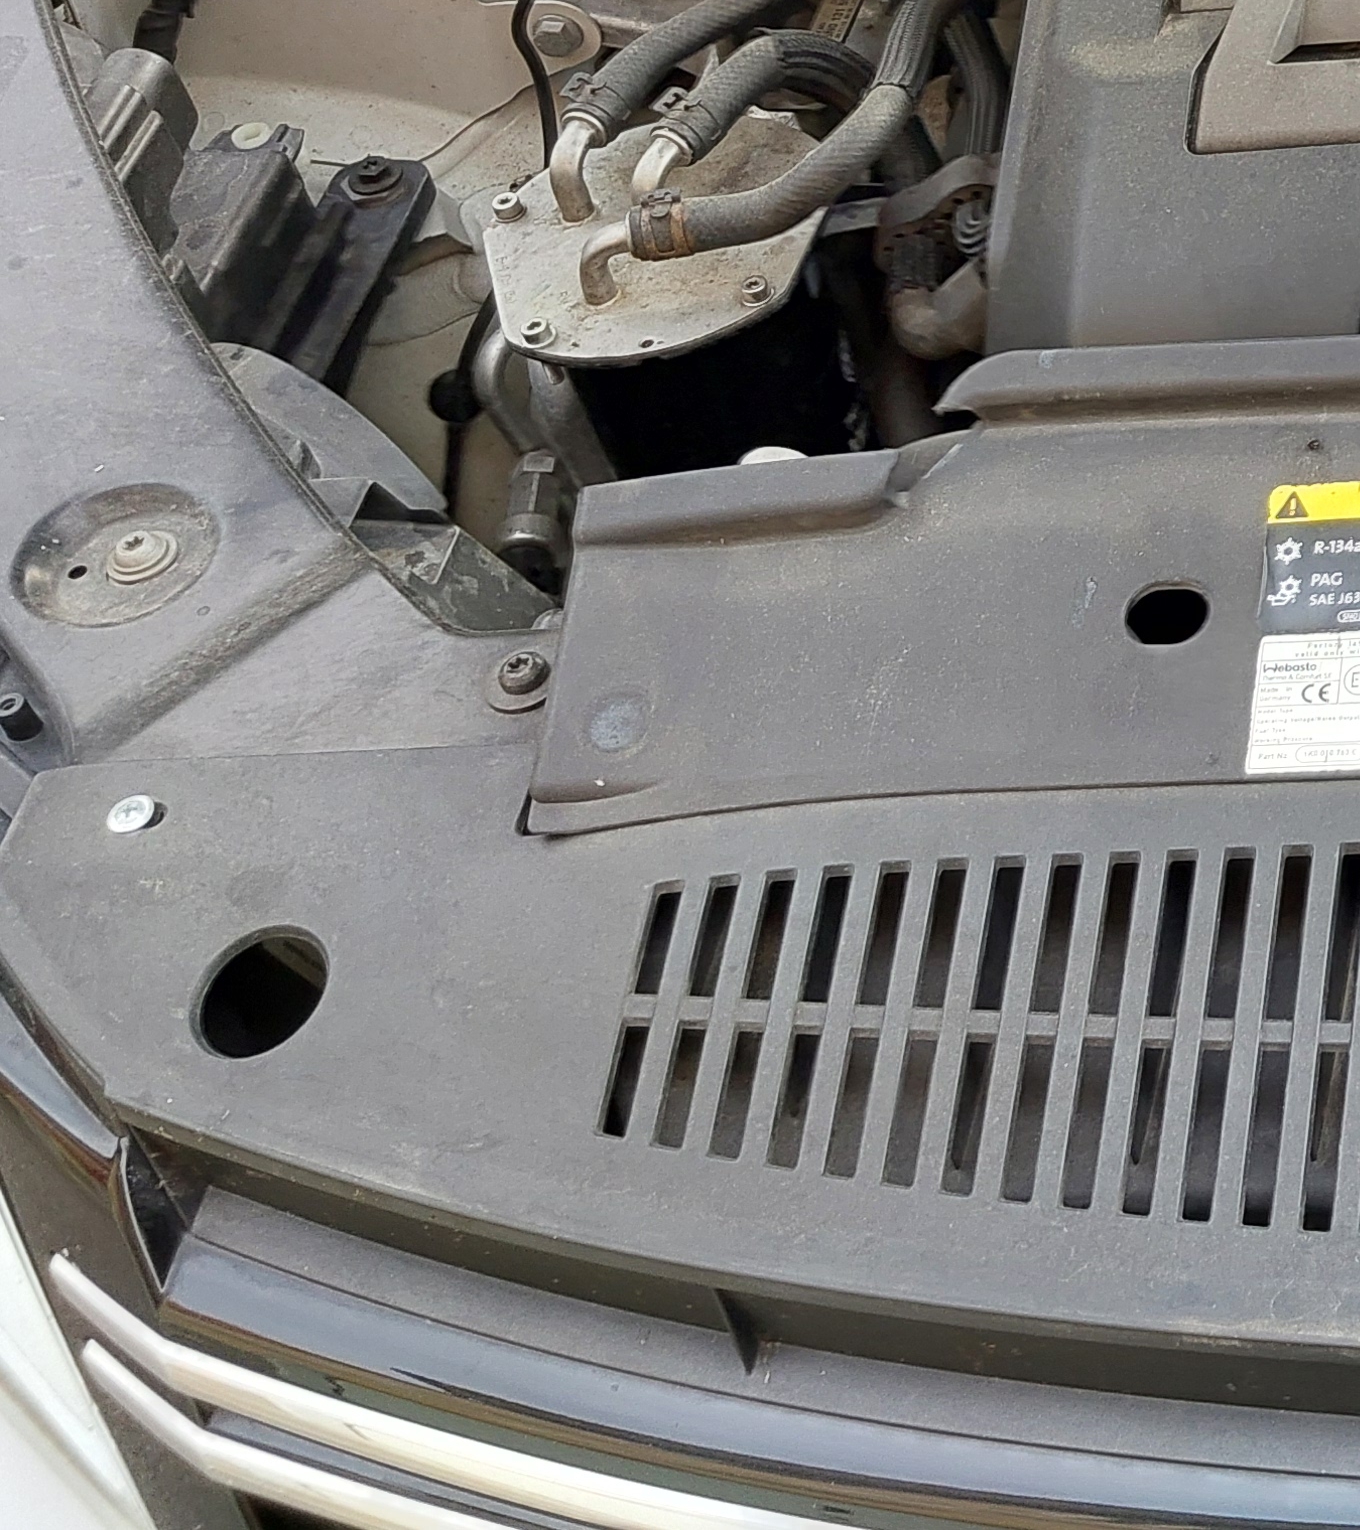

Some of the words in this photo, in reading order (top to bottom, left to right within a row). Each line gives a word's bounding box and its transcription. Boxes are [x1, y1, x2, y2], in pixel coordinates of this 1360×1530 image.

[1311, 572, 1343, 587] PAG
[1309, 593, 1335, 606] SAE
[1263, 662, 1318, 673] Webasto
[1258, 752, 1274, 760] Part
